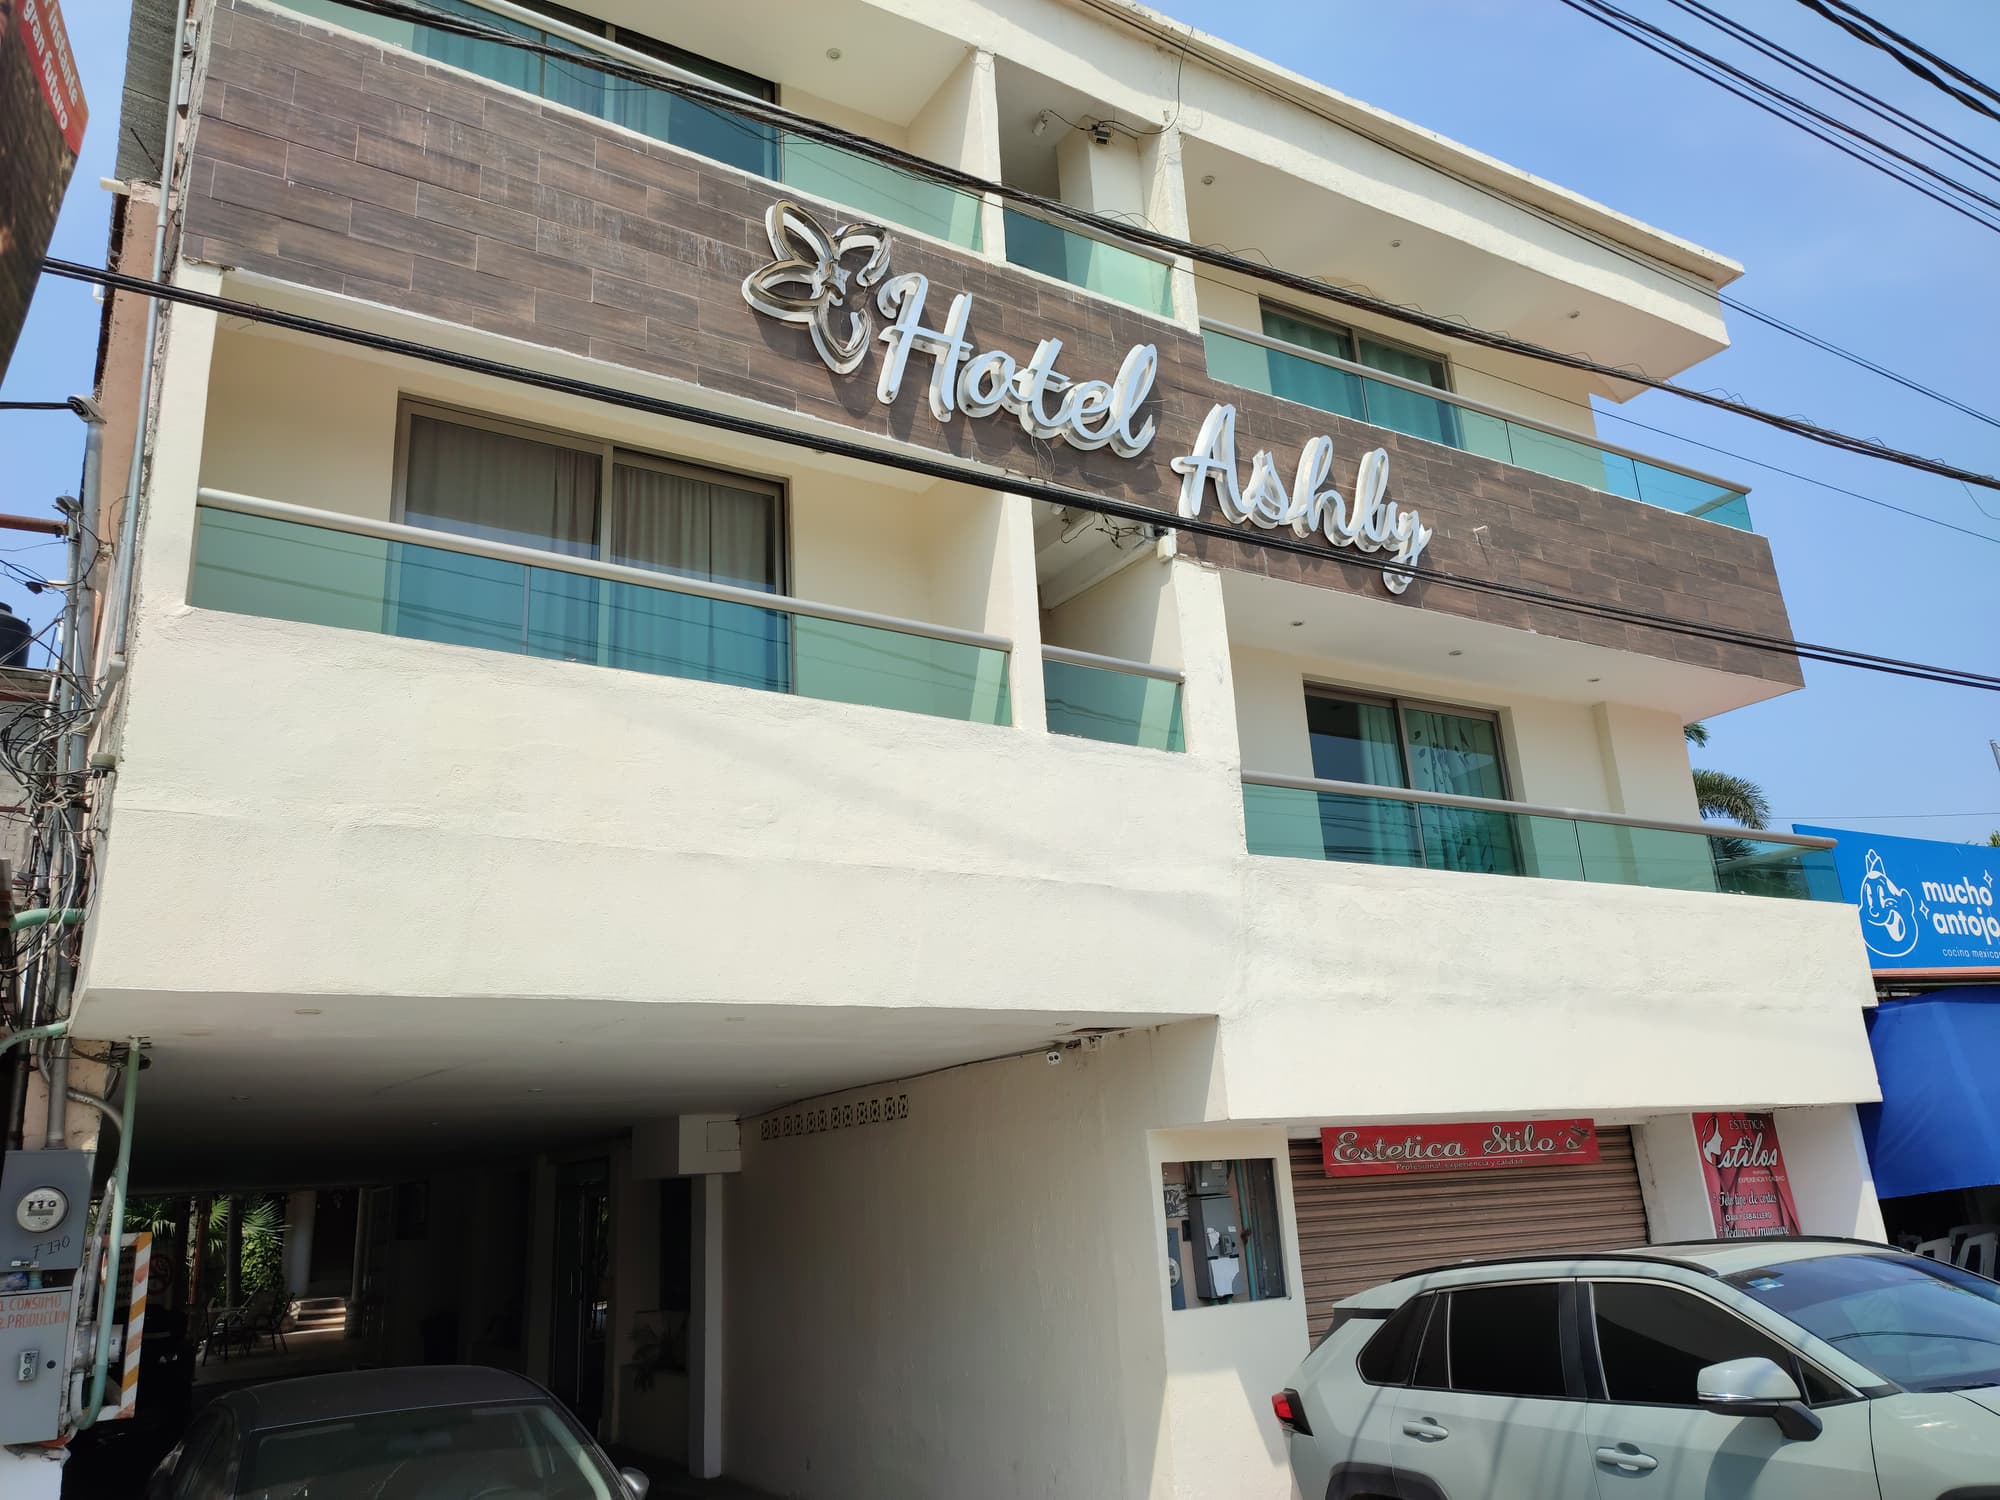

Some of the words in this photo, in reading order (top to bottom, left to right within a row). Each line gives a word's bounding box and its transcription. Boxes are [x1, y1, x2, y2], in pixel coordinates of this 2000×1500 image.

[23, 0, 46, 57] gran
[42, 51, 69, 130] futuro
[49, 4, 79, 107] instante
[876, 272, 1158, 459] Hotel
[1921, 876, 1993, 906] mucho
[1932, 907, 2000, 945] antojo
[1942, 946, 1970, 957] cocina
[1729, 1119, 1766, 1130] ESTETICA
[1332, 1131, 1466, 1163] Estetica
